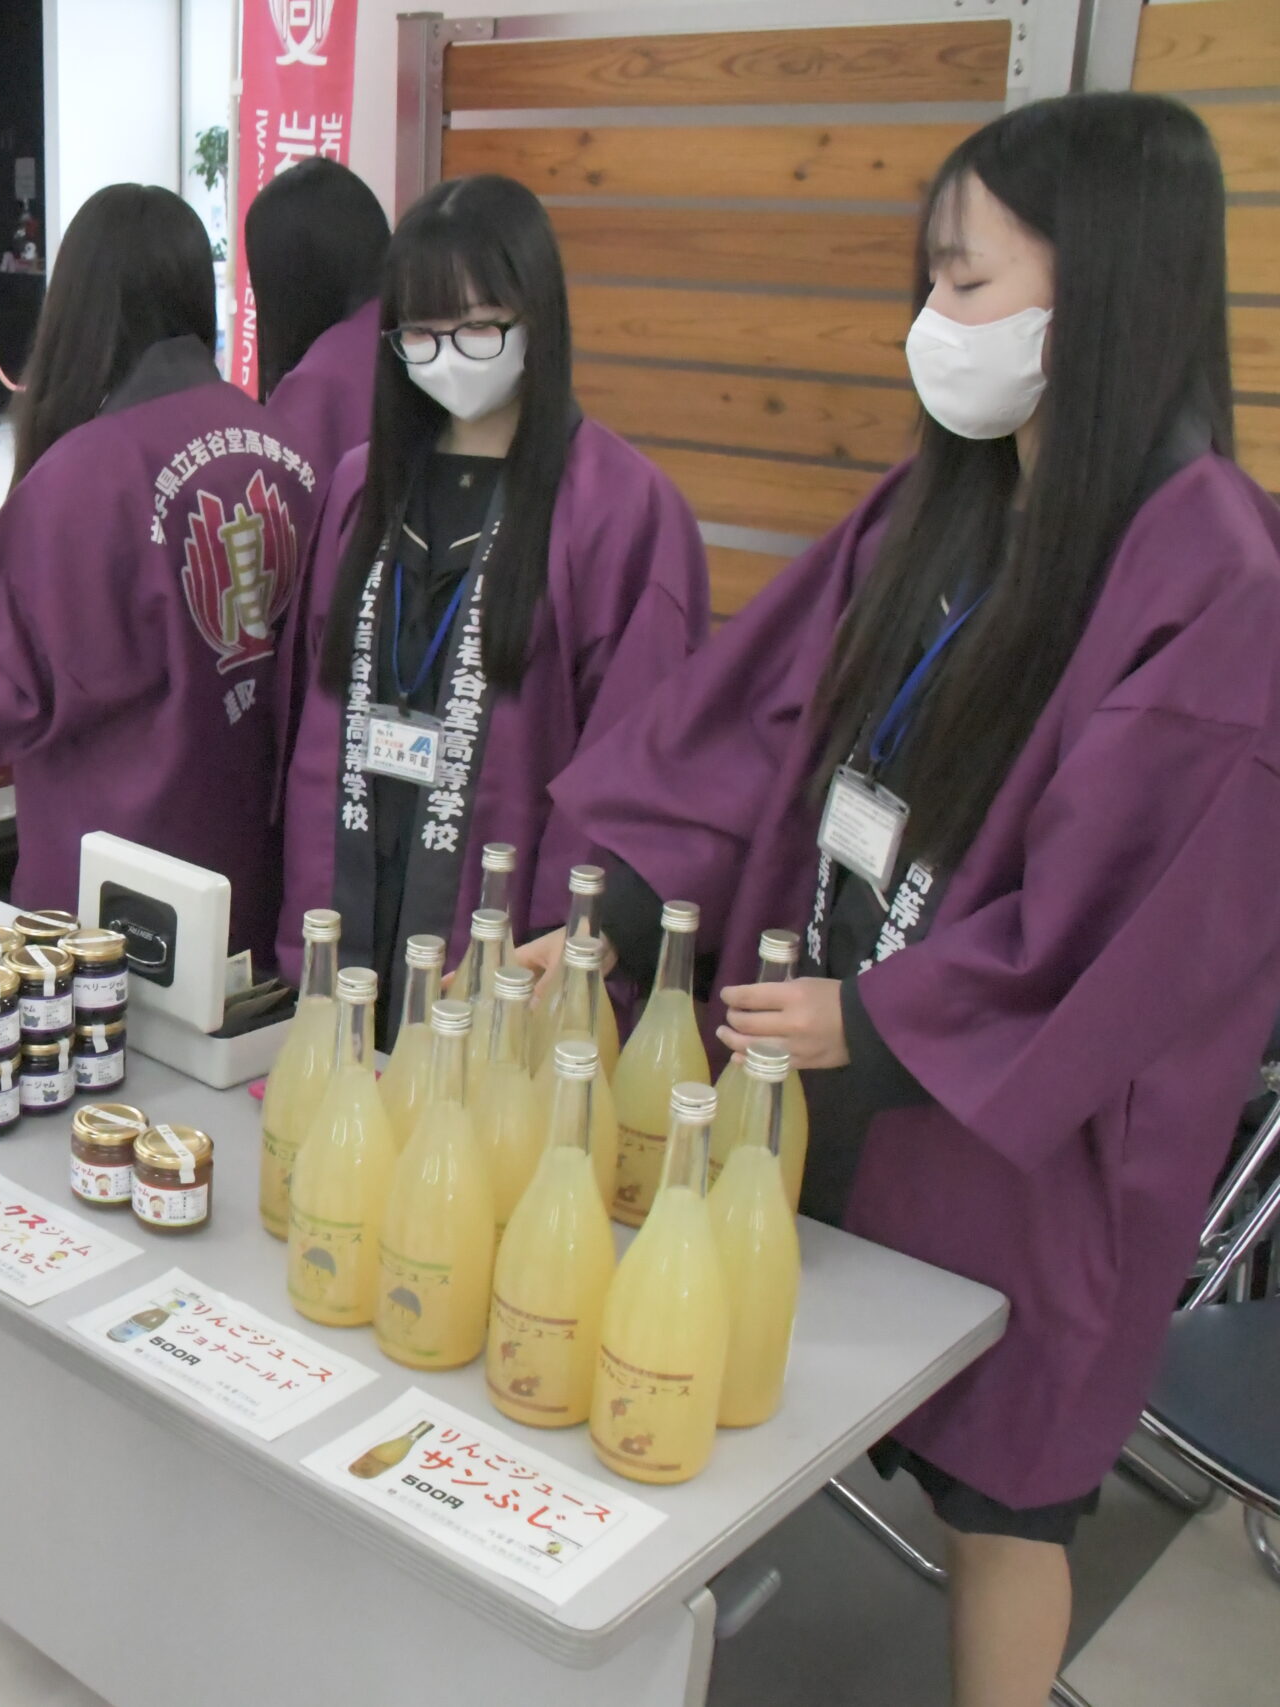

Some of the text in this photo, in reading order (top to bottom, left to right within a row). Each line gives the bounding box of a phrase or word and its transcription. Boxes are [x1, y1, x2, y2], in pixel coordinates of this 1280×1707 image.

[373, 745, 429, 768] 立入許可証
[0, 1242, 64, 1274] いちご
[148, 1335, 202, 1367] 500円
[176, 1322, 302, 1392] ジョナゴールド
[190, 1301, 335, 1384] りんごジュース
[400, 1472, 465, 1511] 500円
[419, 1448, 567, 1532] サンふじ
[438, 1427, 614, 1524] りんごジュース
